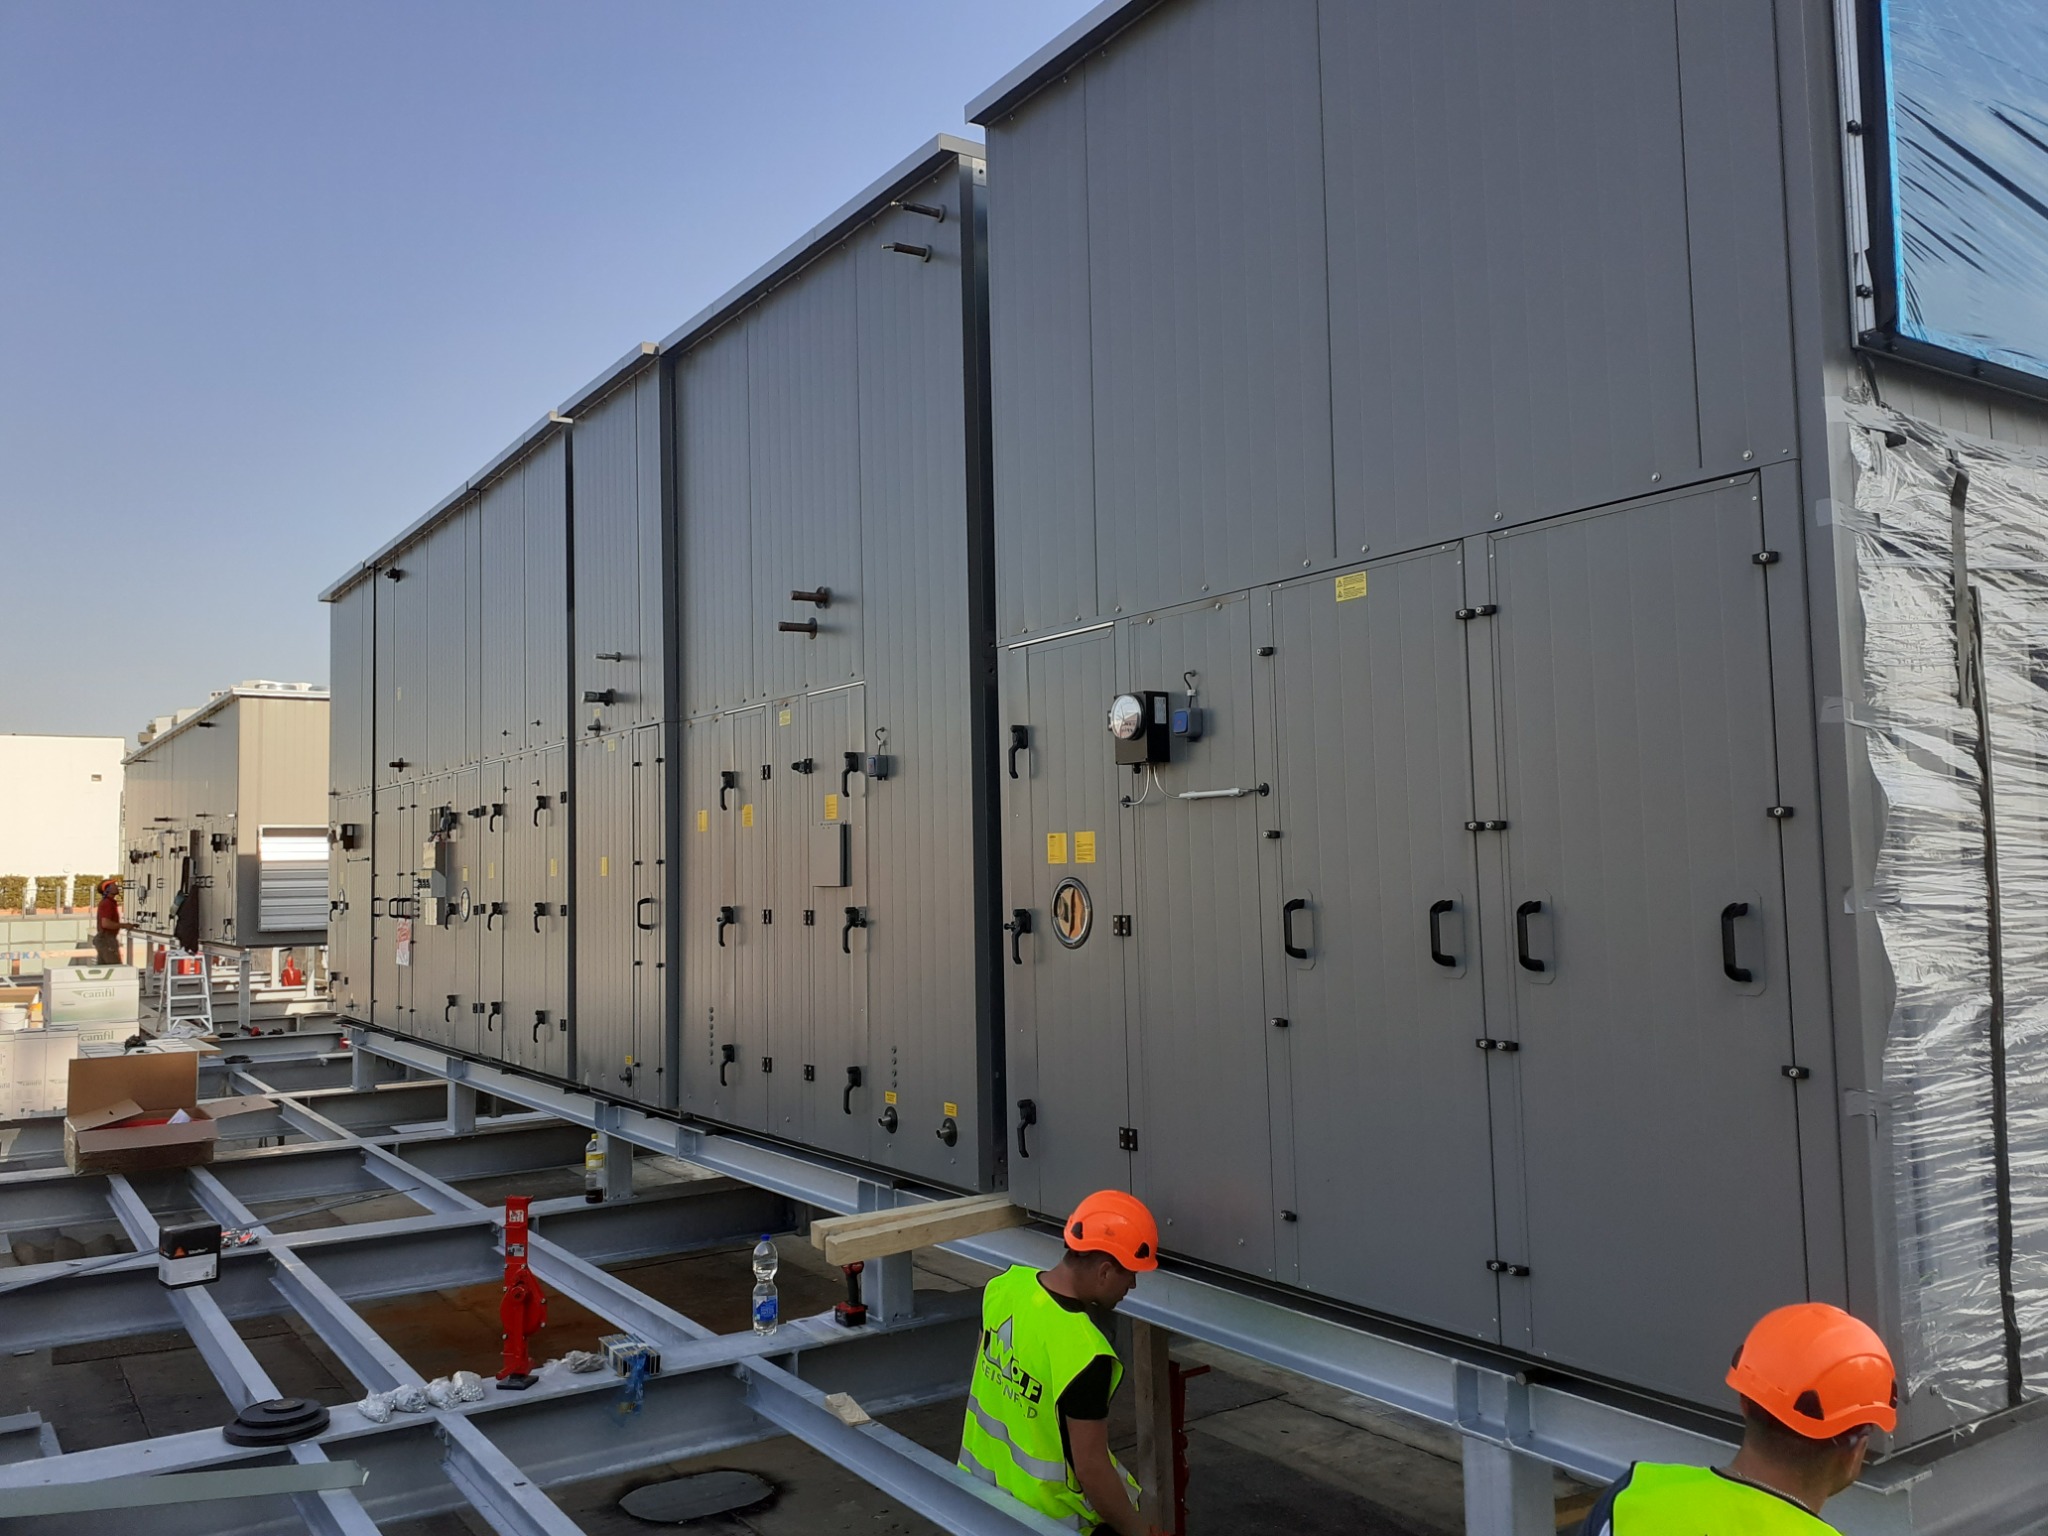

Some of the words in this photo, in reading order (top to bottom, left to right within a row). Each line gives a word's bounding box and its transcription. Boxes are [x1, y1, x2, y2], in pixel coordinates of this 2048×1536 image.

[83, 987, 114, 998] camfil
[81, 1031, 114, 1041] camfil
[985, 1328, 1042, 1404] WOLF
